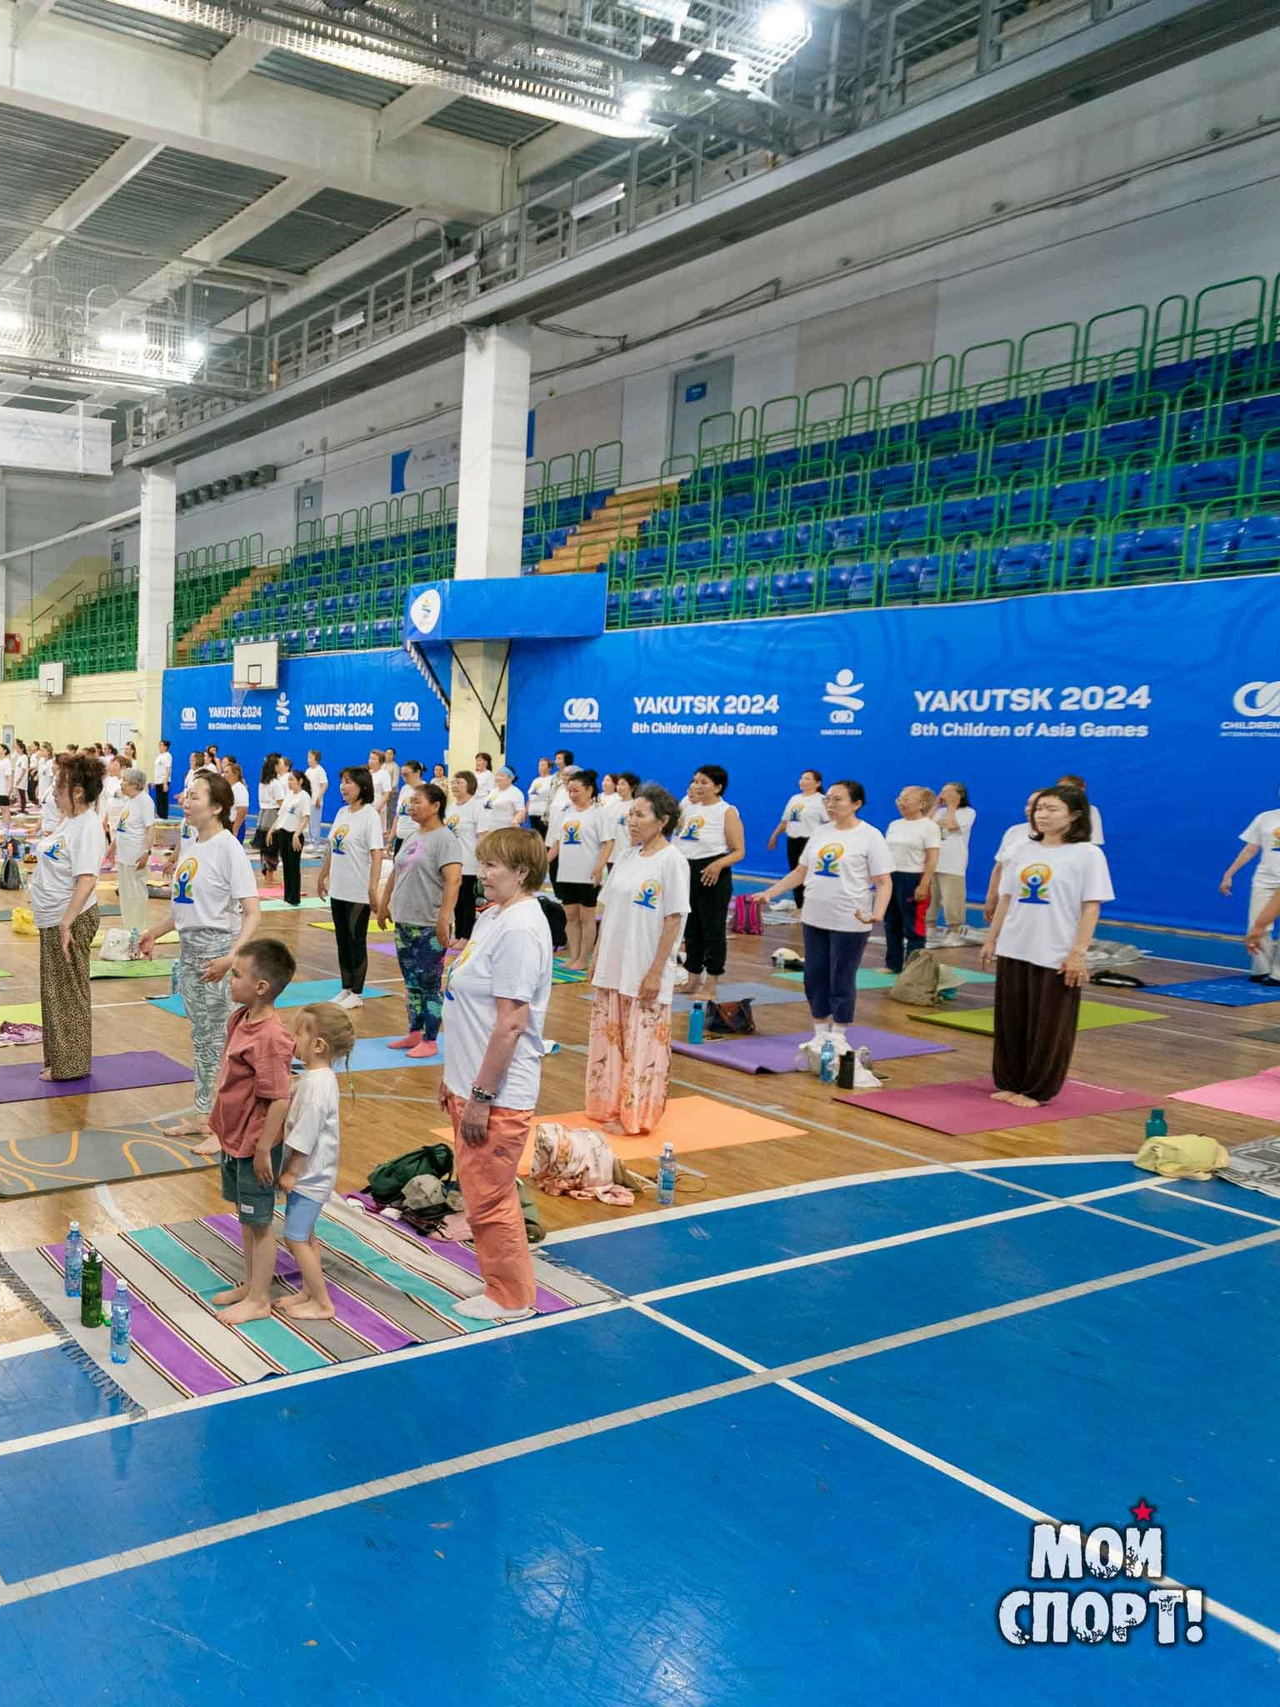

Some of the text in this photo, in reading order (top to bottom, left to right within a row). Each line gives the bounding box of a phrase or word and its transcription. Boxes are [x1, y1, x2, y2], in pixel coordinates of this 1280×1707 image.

[633, 694, 780, 715] YAKUTSK 2024
[914, 685, 1152, 713] YAKUTSK 2024
[208, 706, 262, 718] YAKUTSK 2024
[304, 702, 374, 718] YAKUTSK 2024
[303, 722, 313, 731] 8th
[314, 722, 335, 731] Children
[341, 722, 354, 731] Asia
[354, 722, 374, 731] Games
[631, 722, 778, 736] 8th Children of Asia Games
[910, 722, 1150, 738] 8th Children of Asia Games
